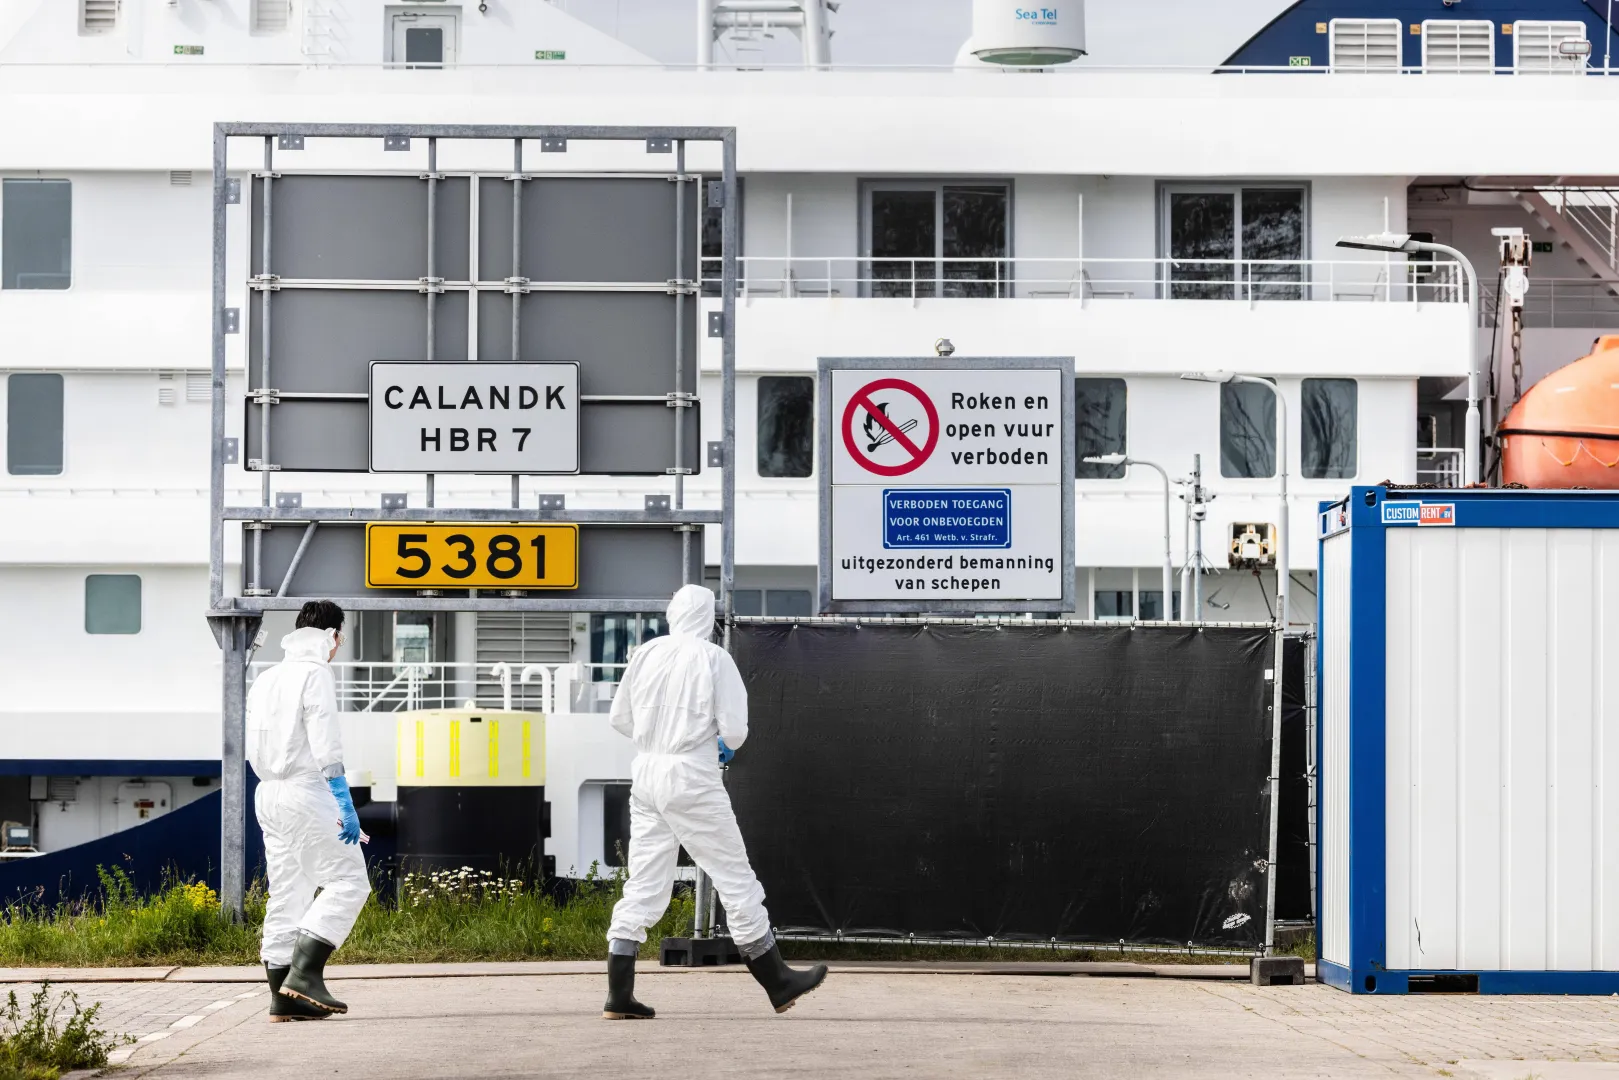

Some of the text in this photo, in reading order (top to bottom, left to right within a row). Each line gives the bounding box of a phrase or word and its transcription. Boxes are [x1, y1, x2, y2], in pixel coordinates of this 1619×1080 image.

[1016, 8, 1056, 20] Sea Tel
[384, 386, 566, 410] CALANDK
[952, 392, 1048, 410] Roken en
[946, 423, 1054, 440] open vuur
[420, 428, 532, 452] HBR 7
[951, 448, 1048, 464] verboden
[890, 500, 1004, 509] VERBODEN TOEGANG
[890, 517, 1004, 526] VOOR ONBEVOEGDEN
[1386, 508, 1419, 520] CUSTOM
[1421, 508, 1440, 518] RENT
[396, 534, 546, 580] 5381
[842, 555, 1054, 574] uitgezonderd bemanning
[895, 576, 1000, 592] van schepen
